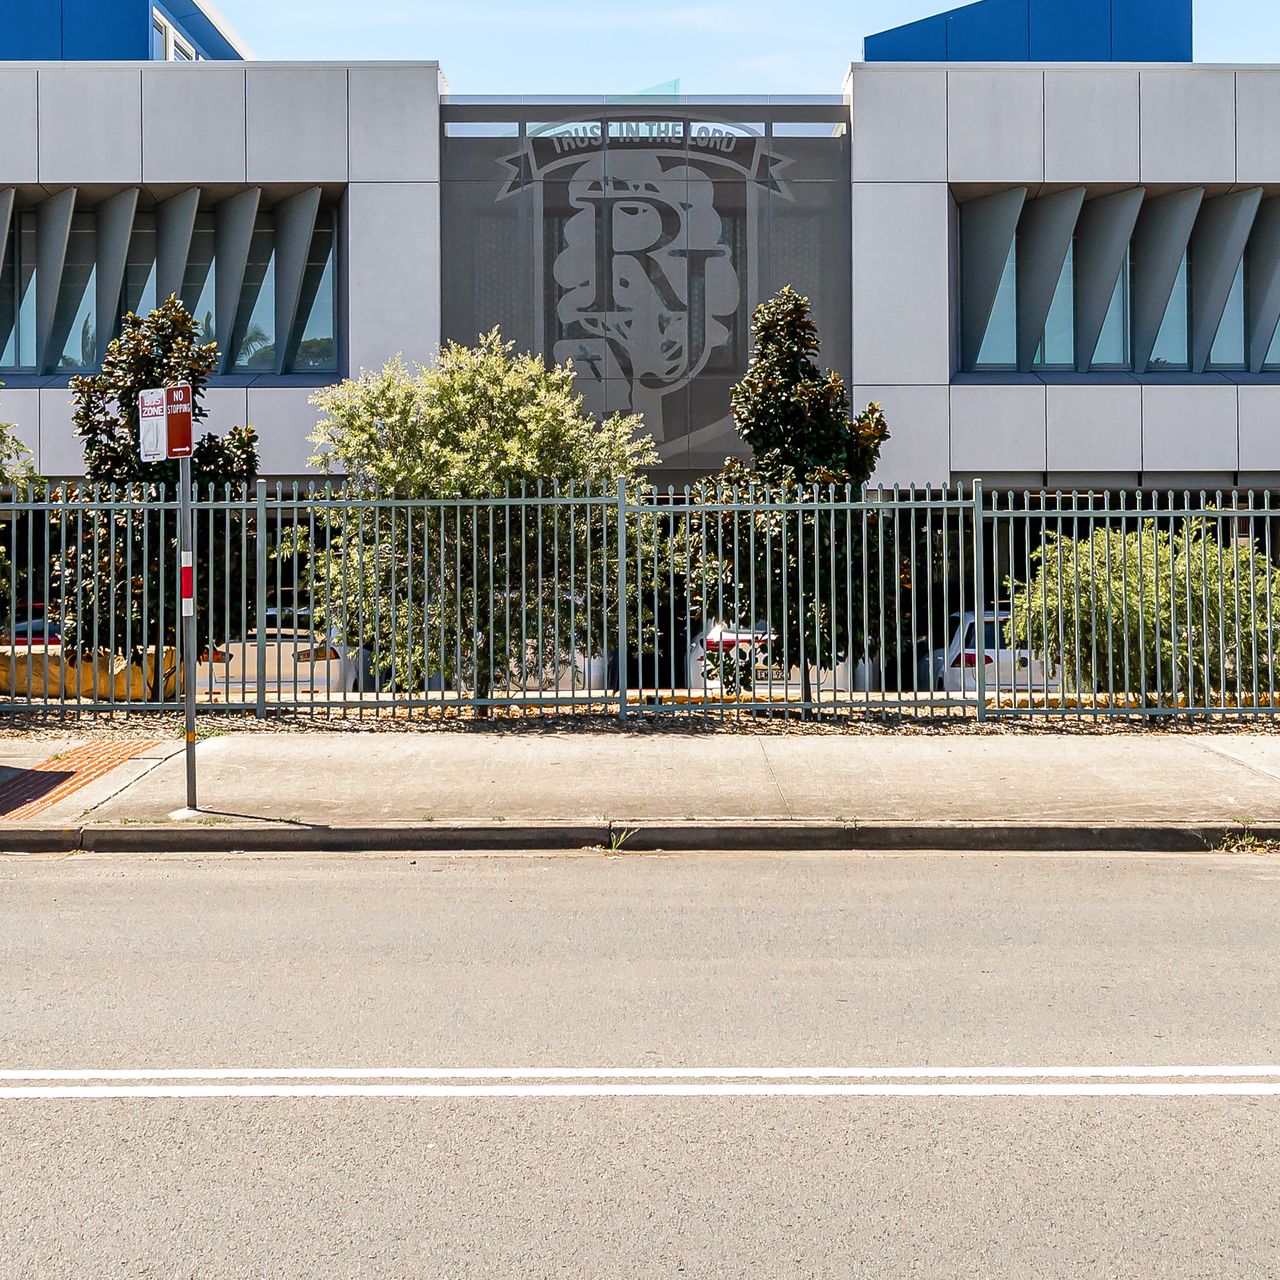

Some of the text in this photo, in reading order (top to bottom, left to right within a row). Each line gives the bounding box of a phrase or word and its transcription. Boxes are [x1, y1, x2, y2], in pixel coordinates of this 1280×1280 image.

[548, 122, 737, 154] TRUST IN THE LORD
[173, 390, 184, 401] NO
[142, 406, 164, 417] ZONE
[167, 403, 191, 415] STOPPING
